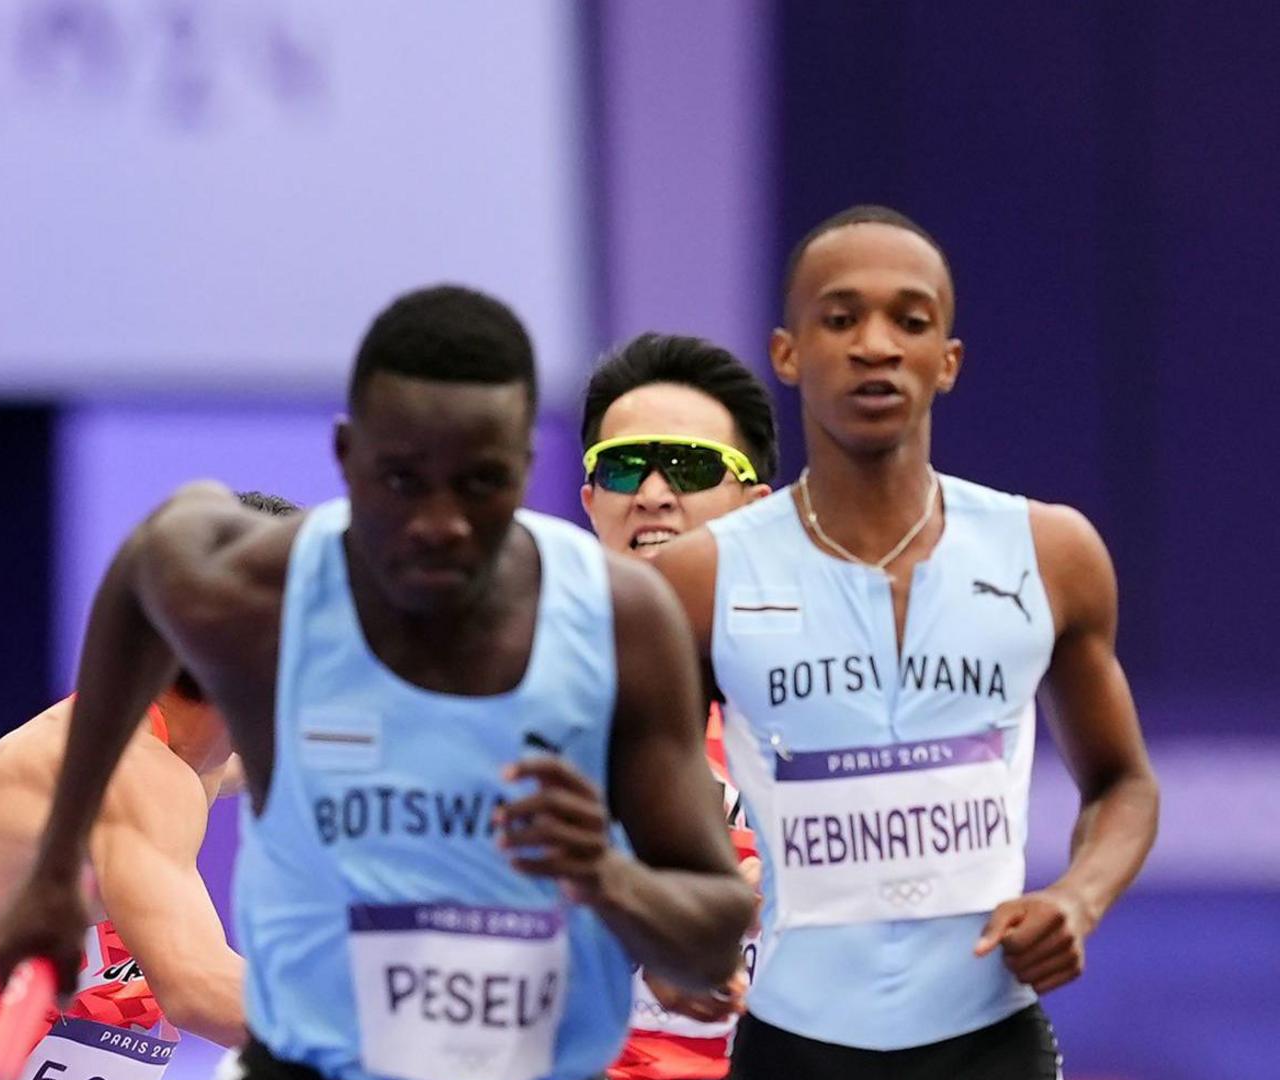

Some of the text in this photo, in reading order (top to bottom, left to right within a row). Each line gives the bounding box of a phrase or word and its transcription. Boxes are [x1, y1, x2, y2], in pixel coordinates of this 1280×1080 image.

[827, 744, 953, 773] PARIS 2024
[782, 797, 1011, 869] KEBINATSHIPI
[100, 1030, 149, 1054] PARIS
